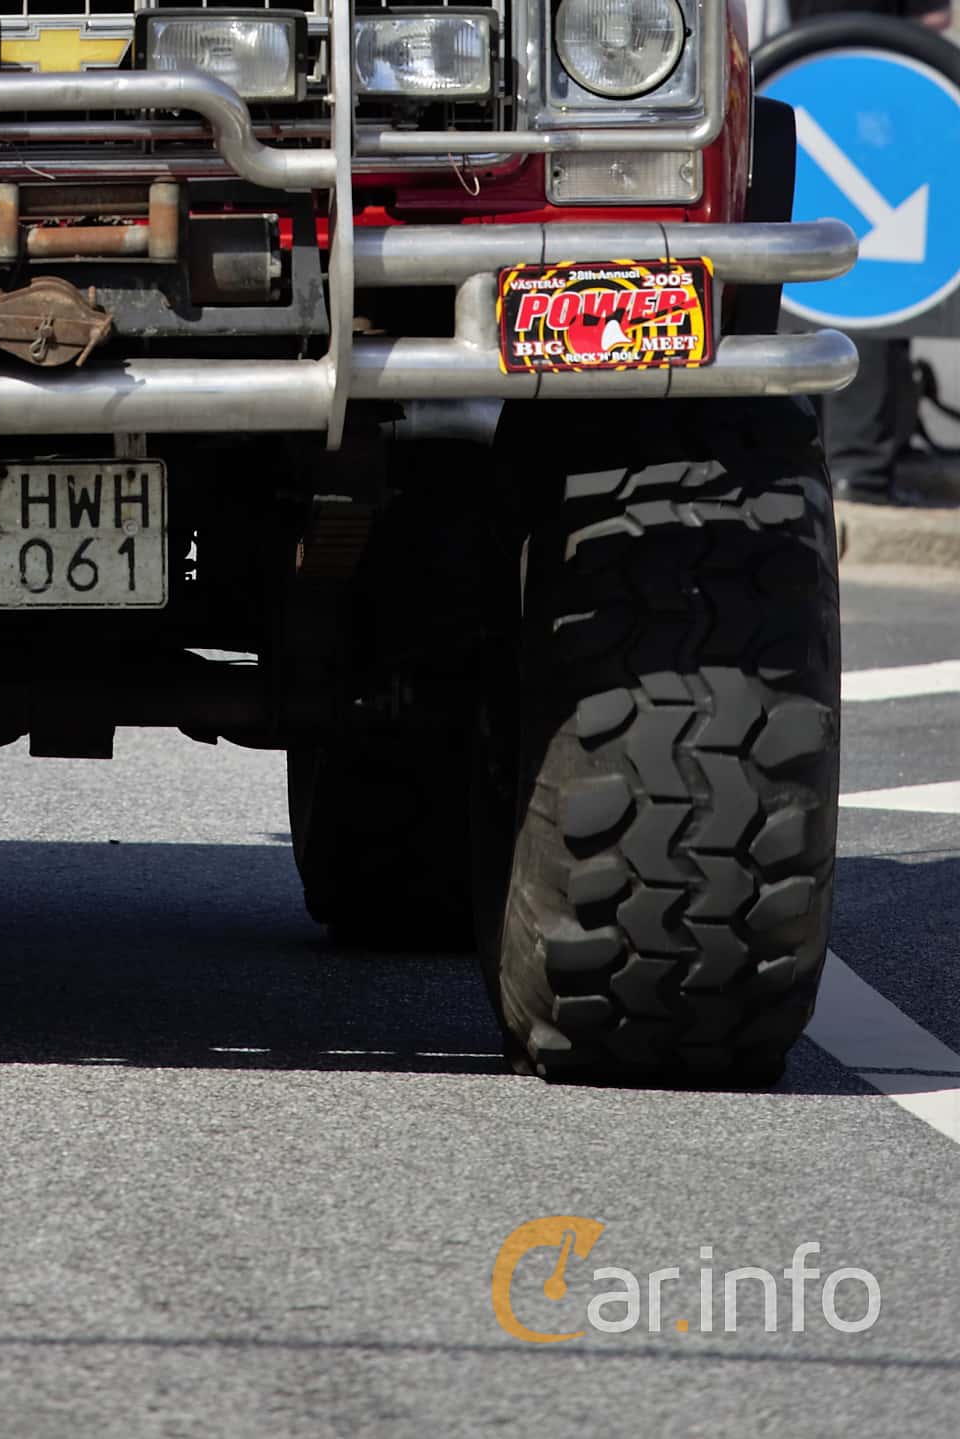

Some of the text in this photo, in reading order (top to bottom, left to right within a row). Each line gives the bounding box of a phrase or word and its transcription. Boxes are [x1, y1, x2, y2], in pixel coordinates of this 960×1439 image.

[598, 270, 640, 280] Annual
[642, 273, 693, 287] 2005
[510, 278, 566, 290] VÄSTERÅS
[515, 288, 692, 331] POWER
[514, 336, 698, 357] BIG MEET
[566, 353, 595, 363] ROCK
[21, 474, 149, 528] HWH
[19, 537, 136, 593] 061
